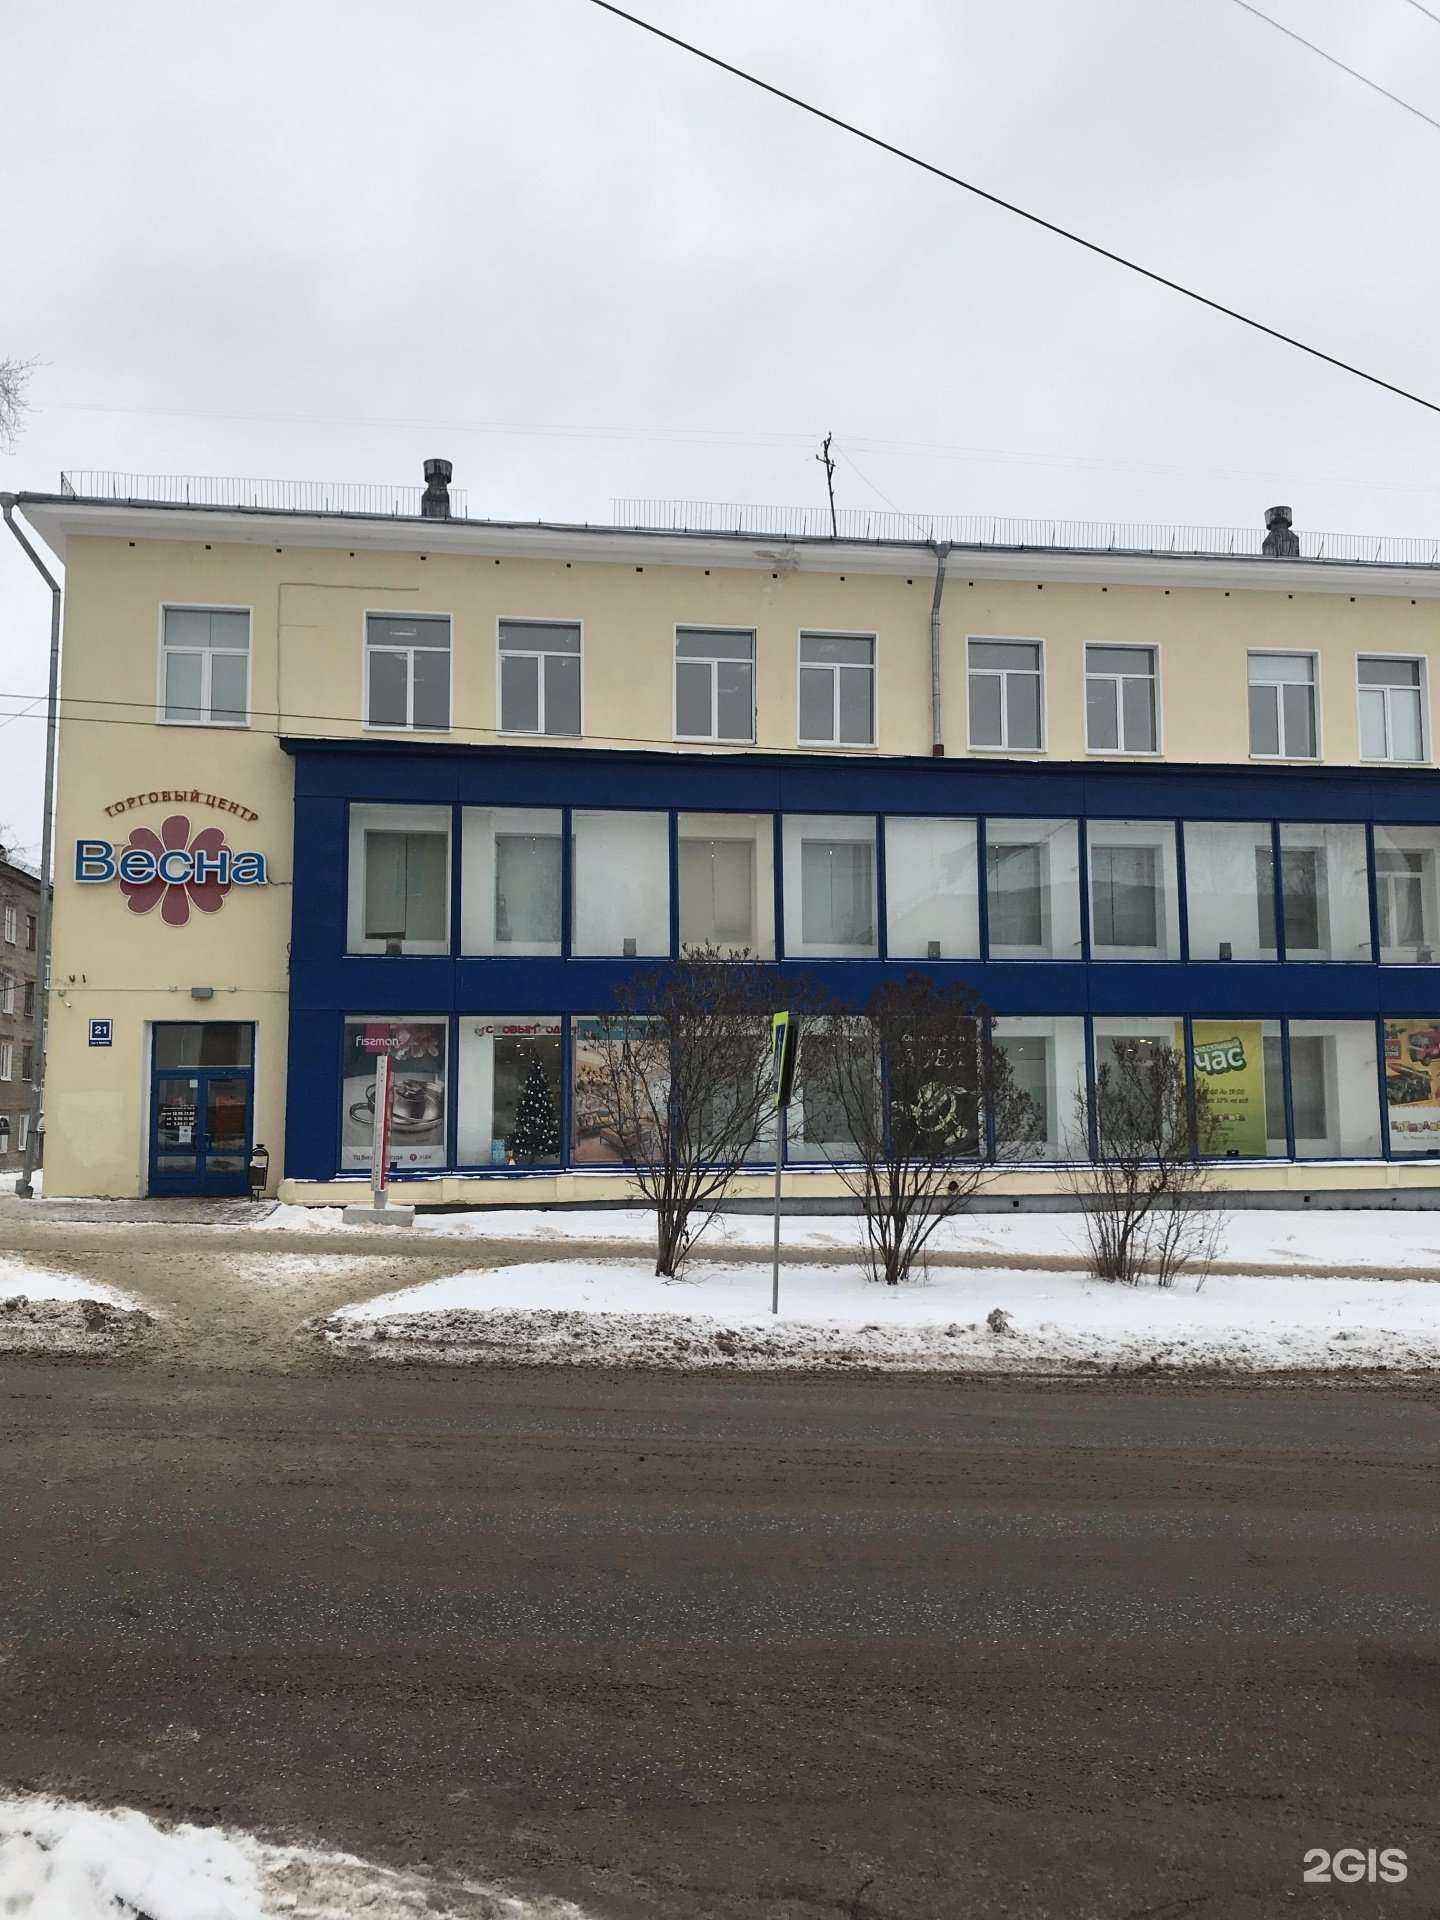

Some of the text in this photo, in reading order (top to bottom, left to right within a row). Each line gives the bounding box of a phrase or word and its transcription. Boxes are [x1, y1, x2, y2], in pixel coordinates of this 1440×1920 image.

[105, 789, 259, 823] ТОРГОВЫЙ ЦЕНТР
[75, 839, 268, 885] Весна
[94, 1025, 107, 1035] 21
